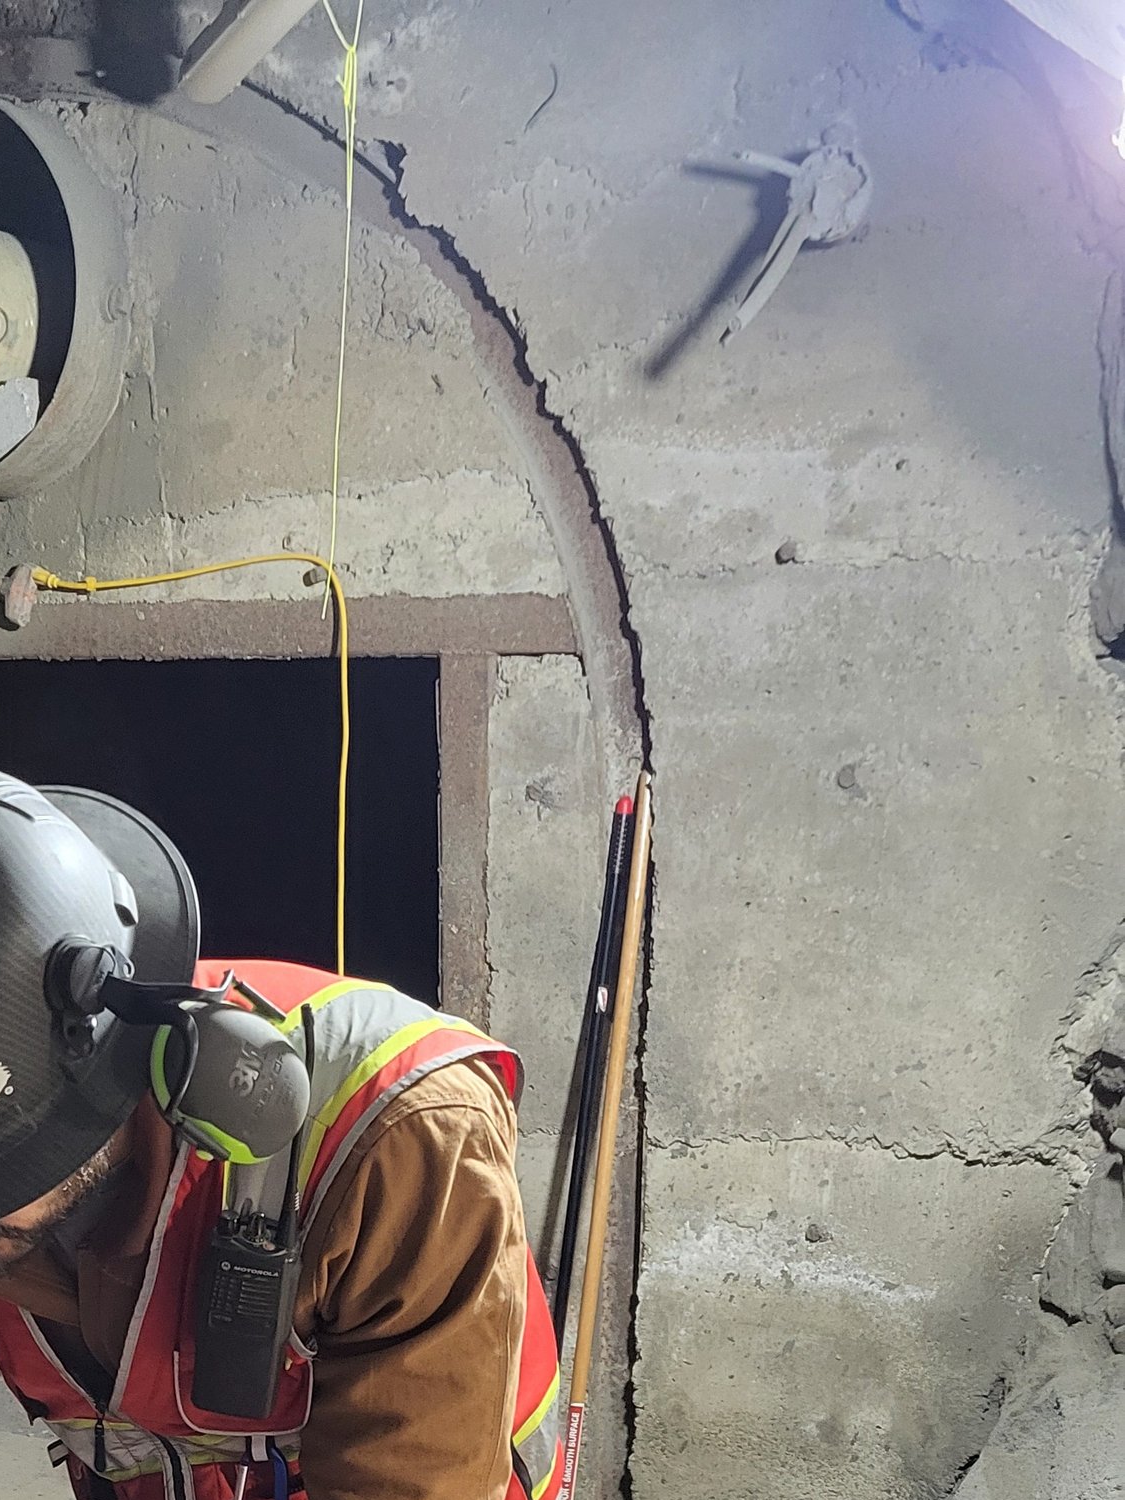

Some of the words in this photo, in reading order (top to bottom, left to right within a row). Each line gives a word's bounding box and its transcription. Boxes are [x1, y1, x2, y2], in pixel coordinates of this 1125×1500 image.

[229, 1048, 263, 1096] 3M
[233, 1266, 279, 1277] MOTOROLA
[568, 1412, 581, 1448] SURFACE
[562, 1449, 575, 1484] SMOOTH
